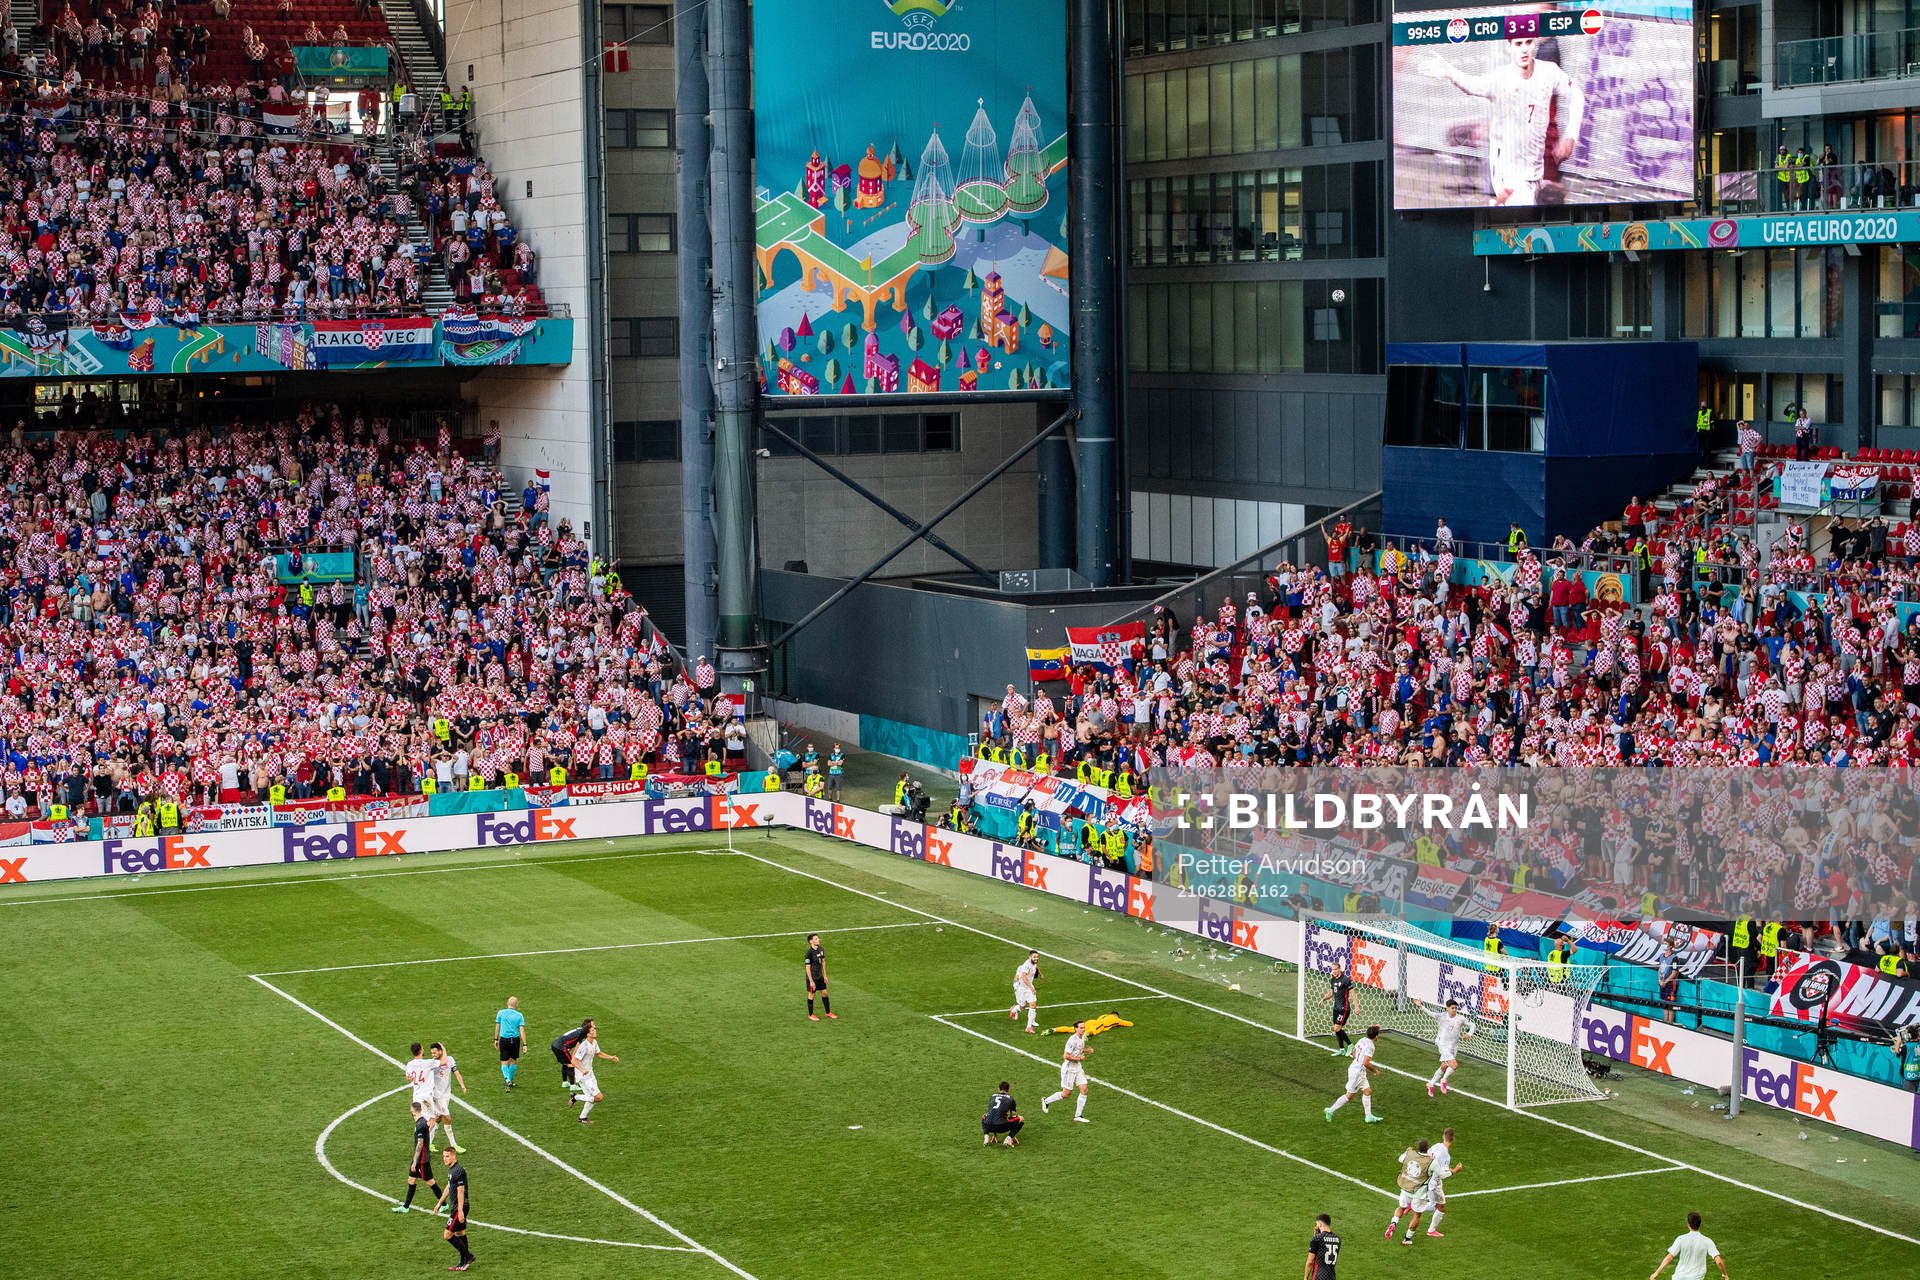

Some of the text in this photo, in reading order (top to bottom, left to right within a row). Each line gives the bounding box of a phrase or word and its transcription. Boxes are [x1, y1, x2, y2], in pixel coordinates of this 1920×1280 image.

[903, 15, 934, 28] UEFA
[1407, 26, 1441, 40] 99:45
[1474, 22, 1499, 36] CRO
[1549, 17, 1573, 31] ESP
[1763, 217, 1898, 243] UEFA EURO 2020
[572, 781, 641, 795] KAMEŠNICA
[220, 815, 268, 830] HRVATSKA
[477, 809, 577, 845] FedEx
[644, 795, 760, 834] FedEx
[805, 797, 856, 840] FedEx
[103, 836, 212, 873] FedEx
[284, 821, 407, 862] FedEx
[890, 815, 953, 867] FedEx
[991, 842, 1048, 890] FedEx
[1088, 865, 1157, 922] FedEx
[1198, 897, 1259, 951] FedEx
[1305, 919, 1387, 989] FedEx
[410, 1070, 426, 1086] 24
[1742, 1047, 1839, 1123] FedEx
[992, 1096, 1003, 1109] 5
[1324, 1244, 1339, 1265] 25
